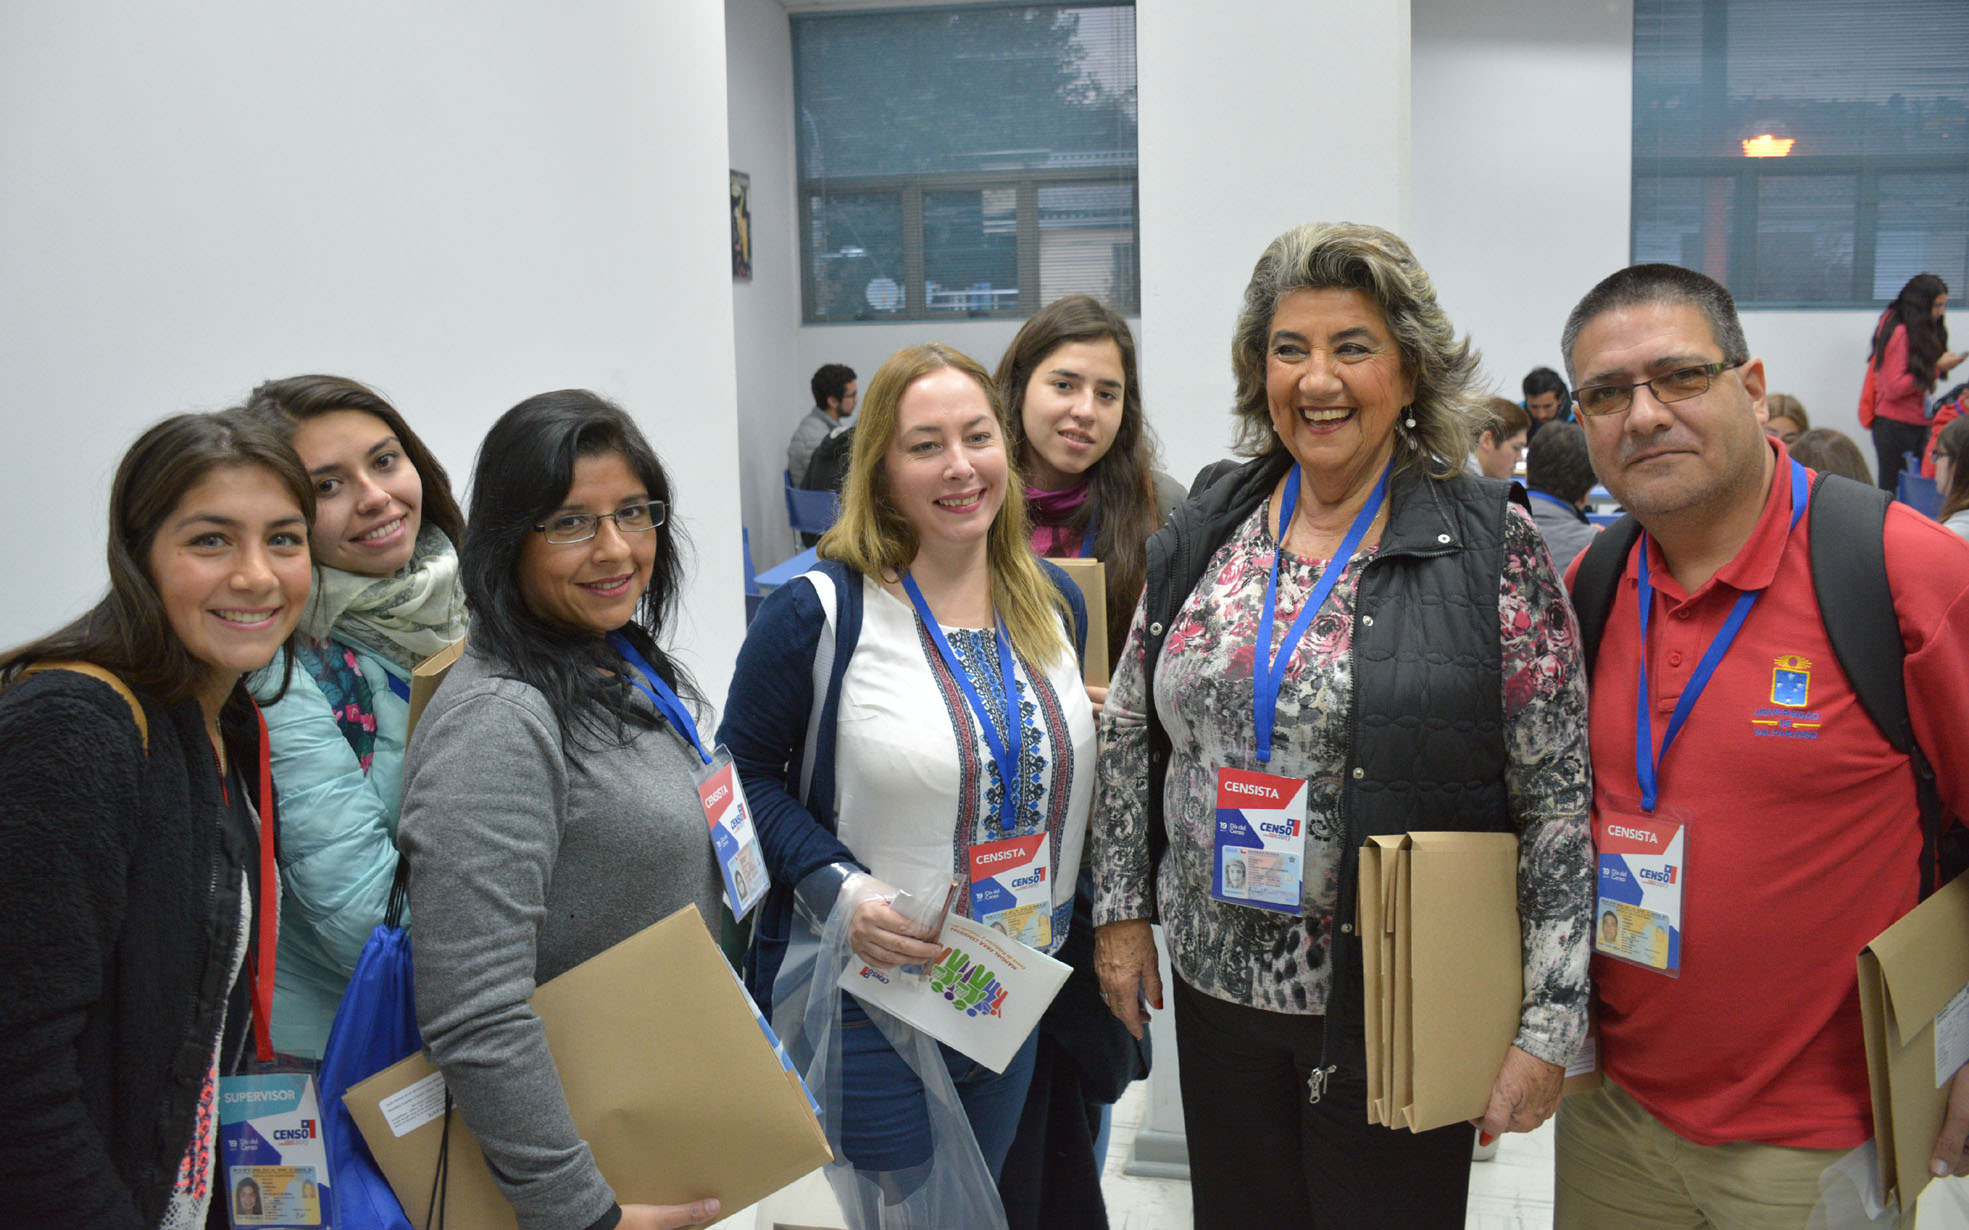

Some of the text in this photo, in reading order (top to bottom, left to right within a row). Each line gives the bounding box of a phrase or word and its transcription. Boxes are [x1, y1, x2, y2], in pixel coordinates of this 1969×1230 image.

[1223, 781, 1280, 800] CENSISTA
[1260, 822, 1292, 836] CENSO
[1608, 824, 1659, 845] CENSISTA
[975, 847, 1027, 865] CENSISTA
[1011, 875, 1040, 888] CENSO
[1639, 868, 1670, 883] CENSO
[224, 1089, 296, 1104] SUPERVISOR
[273, 1128, 309, 1141] CENSO
